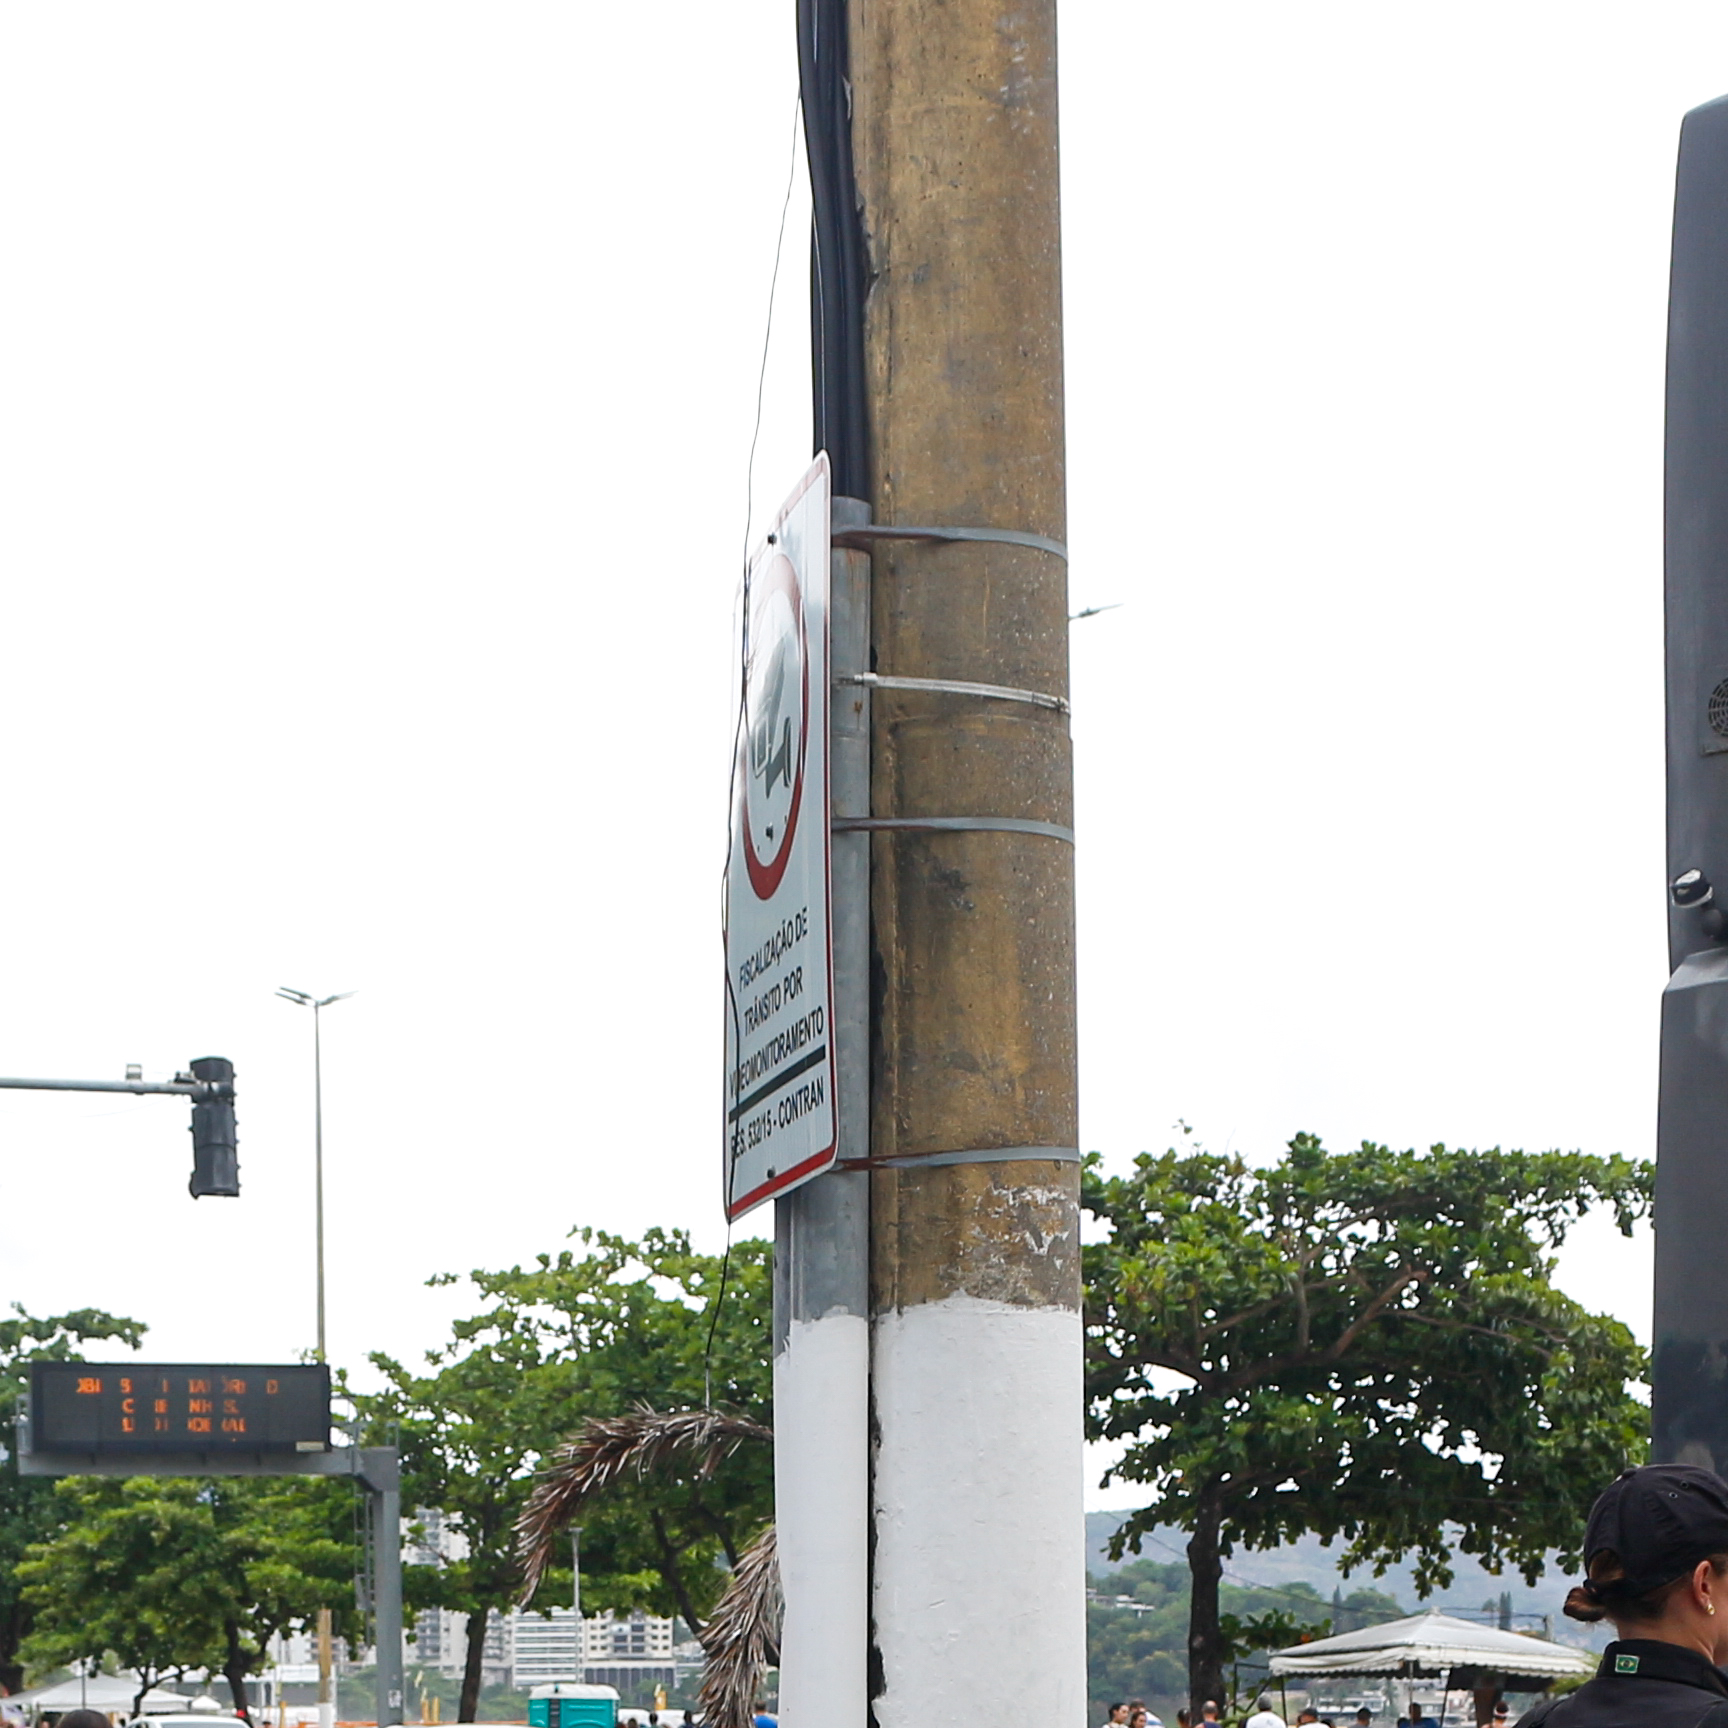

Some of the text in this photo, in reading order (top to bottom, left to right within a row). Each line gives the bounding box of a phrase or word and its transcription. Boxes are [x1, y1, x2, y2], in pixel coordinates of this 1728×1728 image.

[739, 906, 808, 993] FISCALIZAÇÃO DE
[744, 966, 803, 1037] TRÂNSITO POR
[748, 1109, 772, 1149] 532/15
[778, 1075, 824, 1130] CONTRAN
